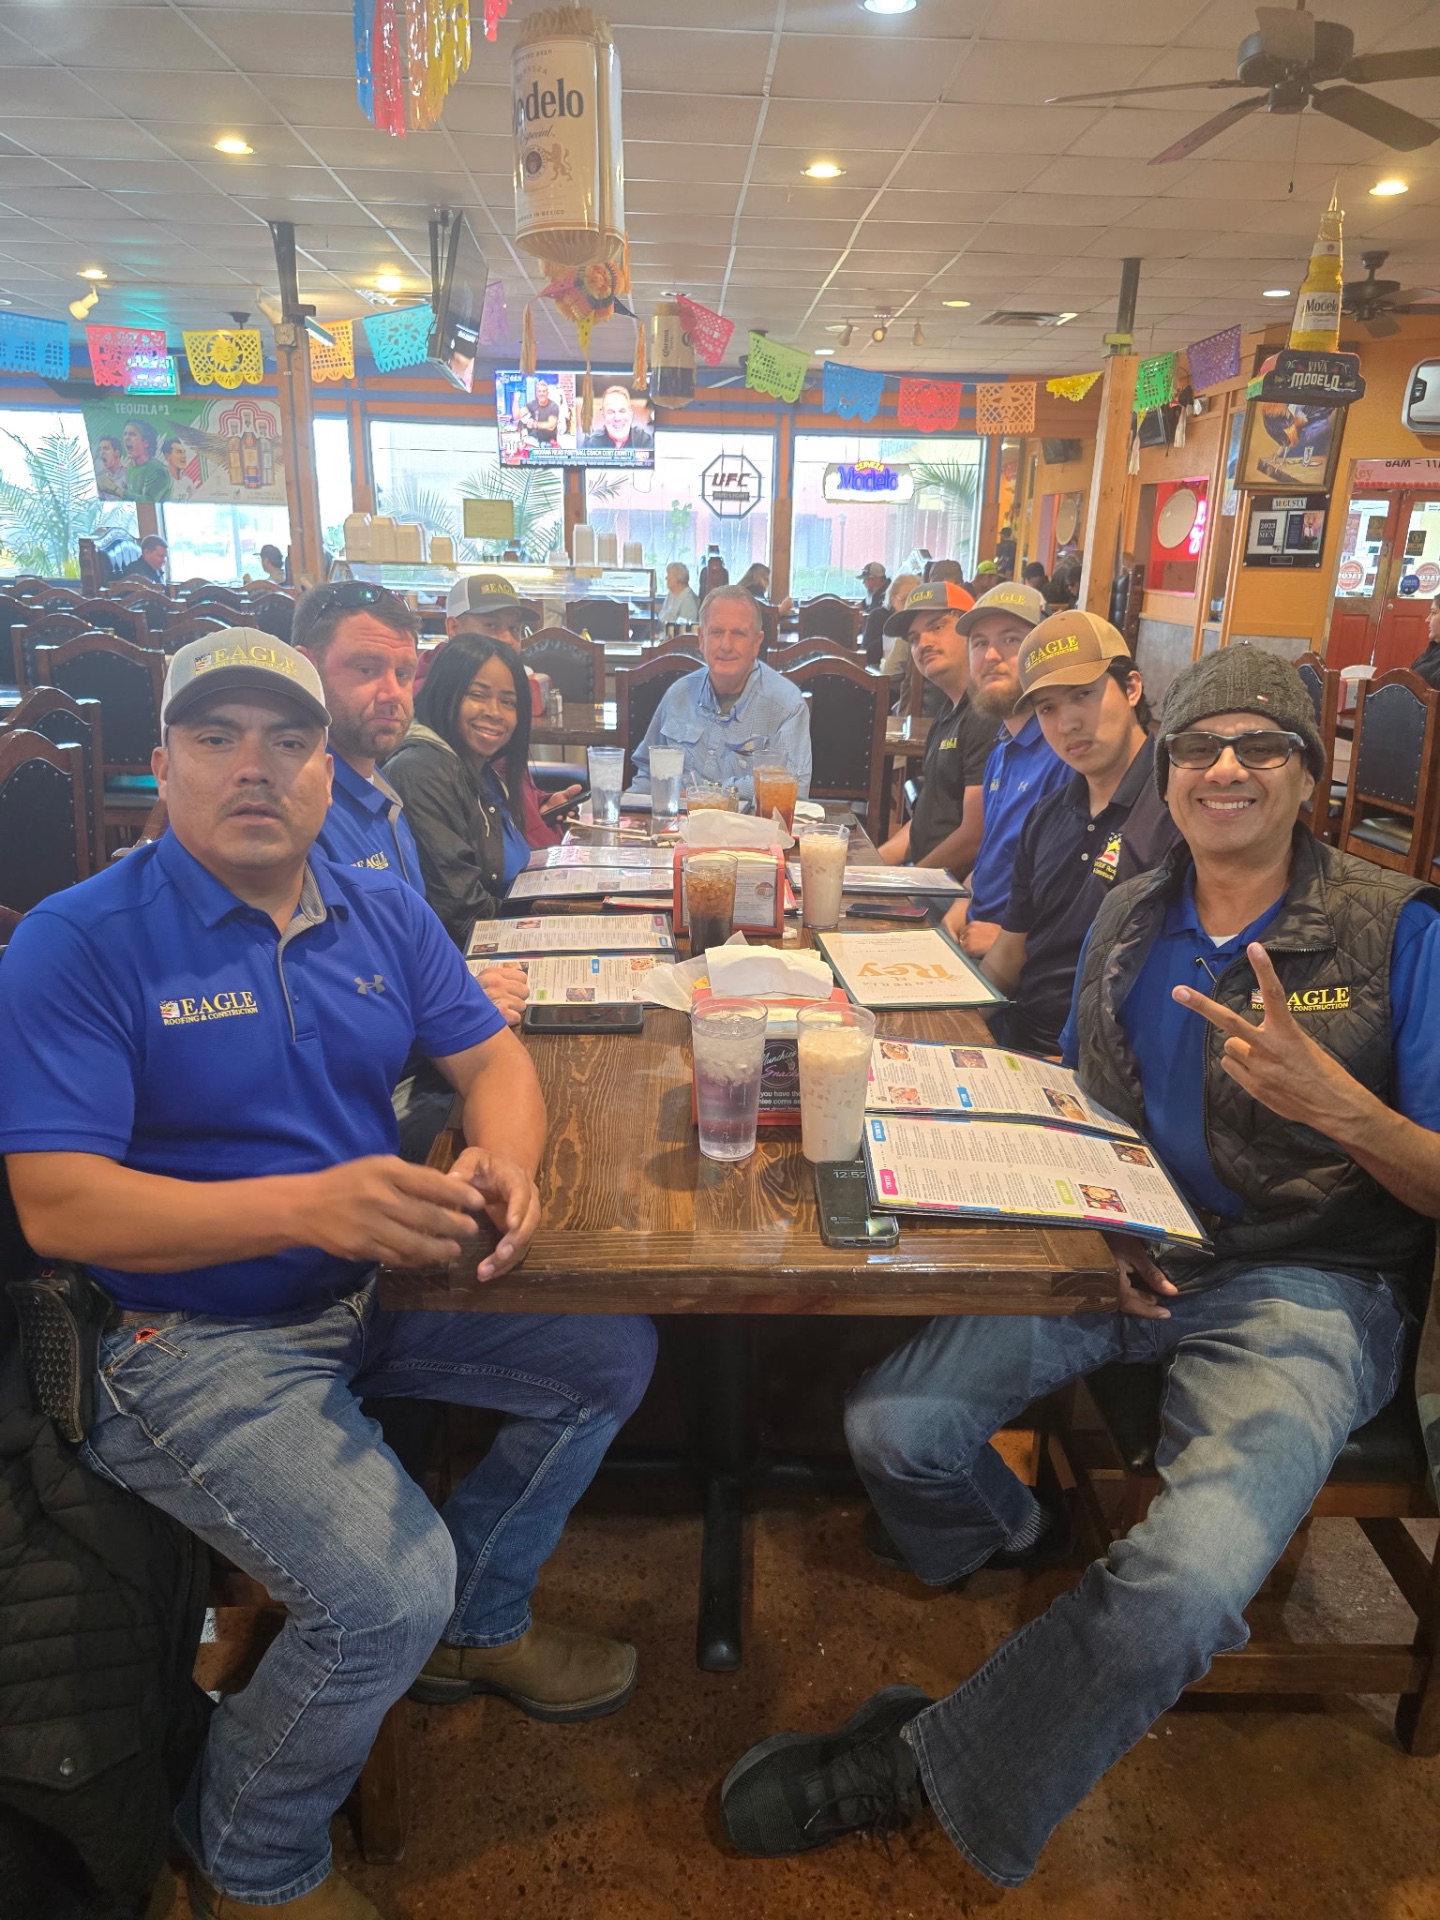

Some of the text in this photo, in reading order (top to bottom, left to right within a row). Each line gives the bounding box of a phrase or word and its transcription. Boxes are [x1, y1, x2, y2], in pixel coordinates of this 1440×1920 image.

[513, 78, 584, 135] odelo
[1304, 299, 1339, 312] Modelo
[1308, 361, 1328, 373] VIVA
[114, 402, 158, 416] TEQUILA
[855, 460, 884, 472] CERVEZA
[712, 473, 750, 487] UFC
[837, 465, 899, 491] Modelo
[214, 645, 295, 669] EAGLE
[1029, 635, 1079, 664] EAGLE
[857, 962, 950, 979] Rey
[179, 991, 257, 1017] EAGLE
[1286, 986, 1350, 1006] AGLE
[1293, 1002, 1349, 1012] CONSTRUCTION
[163, 1014, 200, 1026] ROOFING
[207, 1007, 259, 1020] CONSTRUCTION
